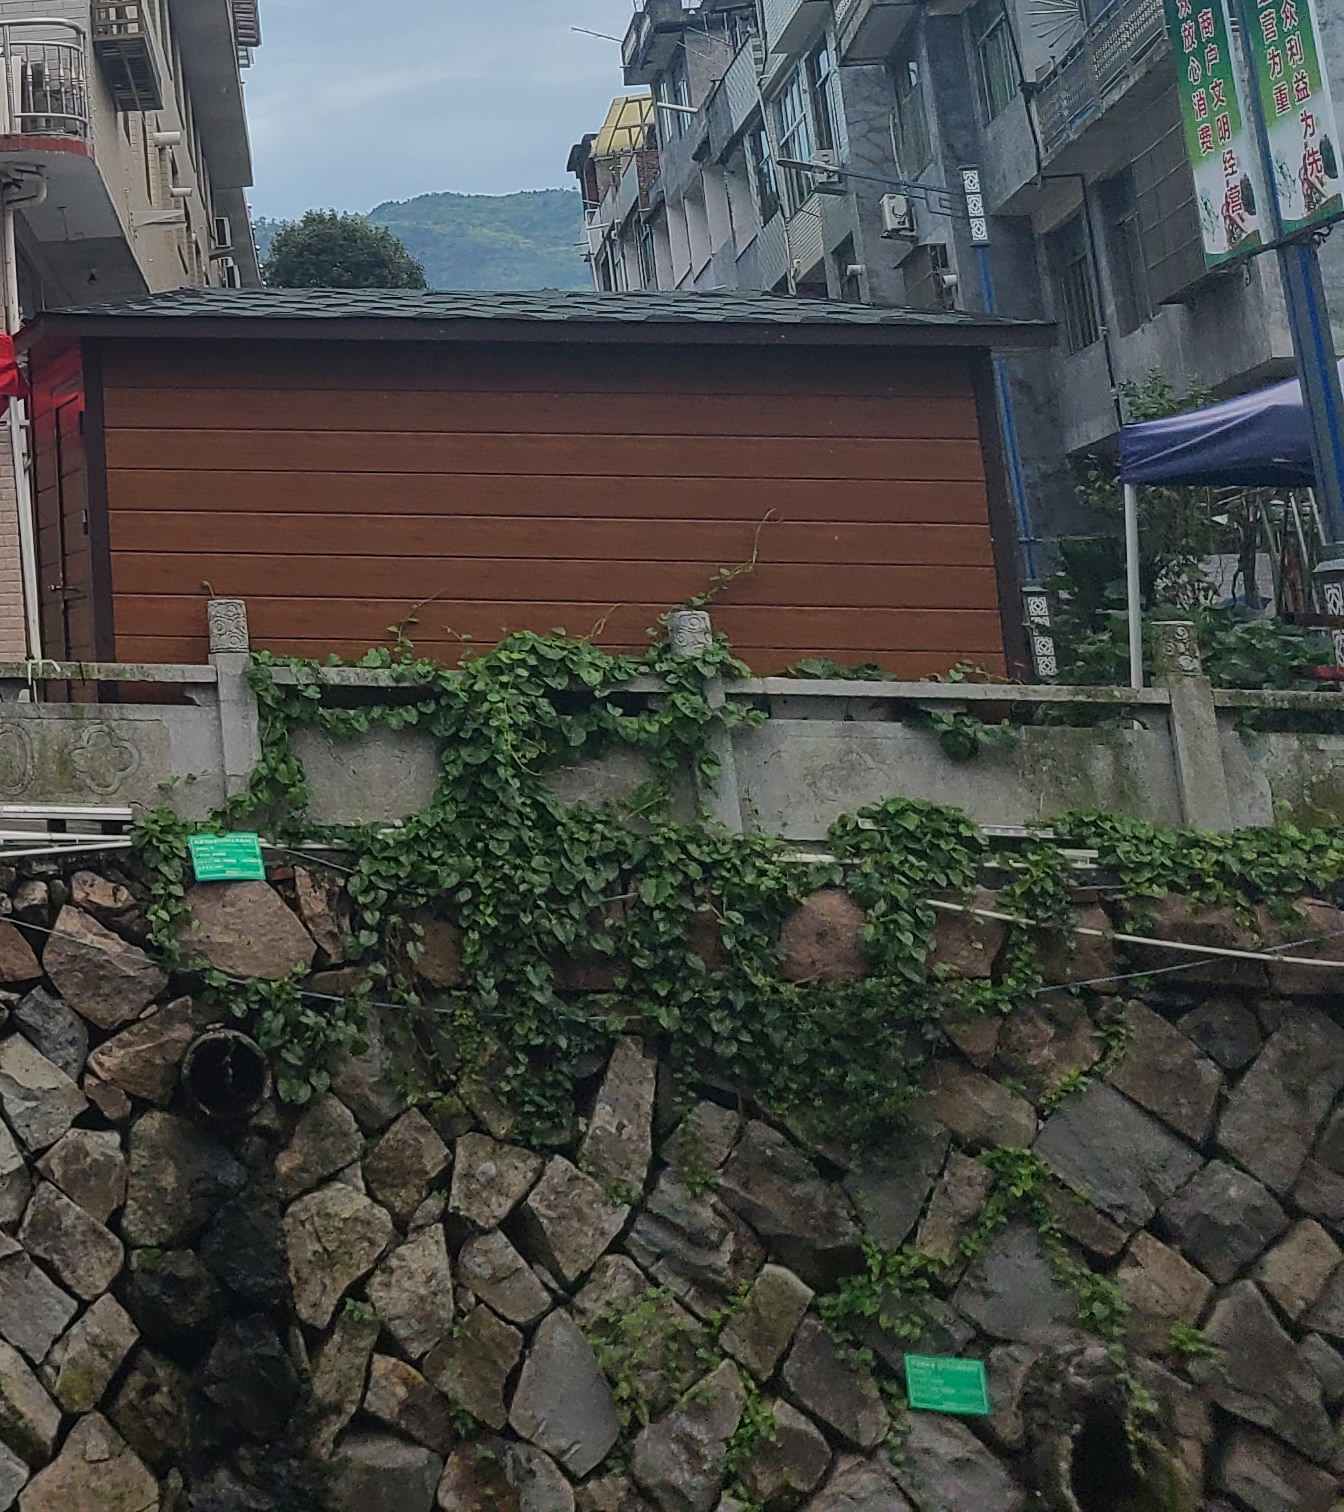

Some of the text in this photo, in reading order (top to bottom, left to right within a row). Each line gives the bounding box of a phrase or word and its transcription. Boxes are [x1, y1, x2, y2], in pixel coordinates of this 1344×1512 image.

[1197, 7, 1244, 215] 商户文明经营
